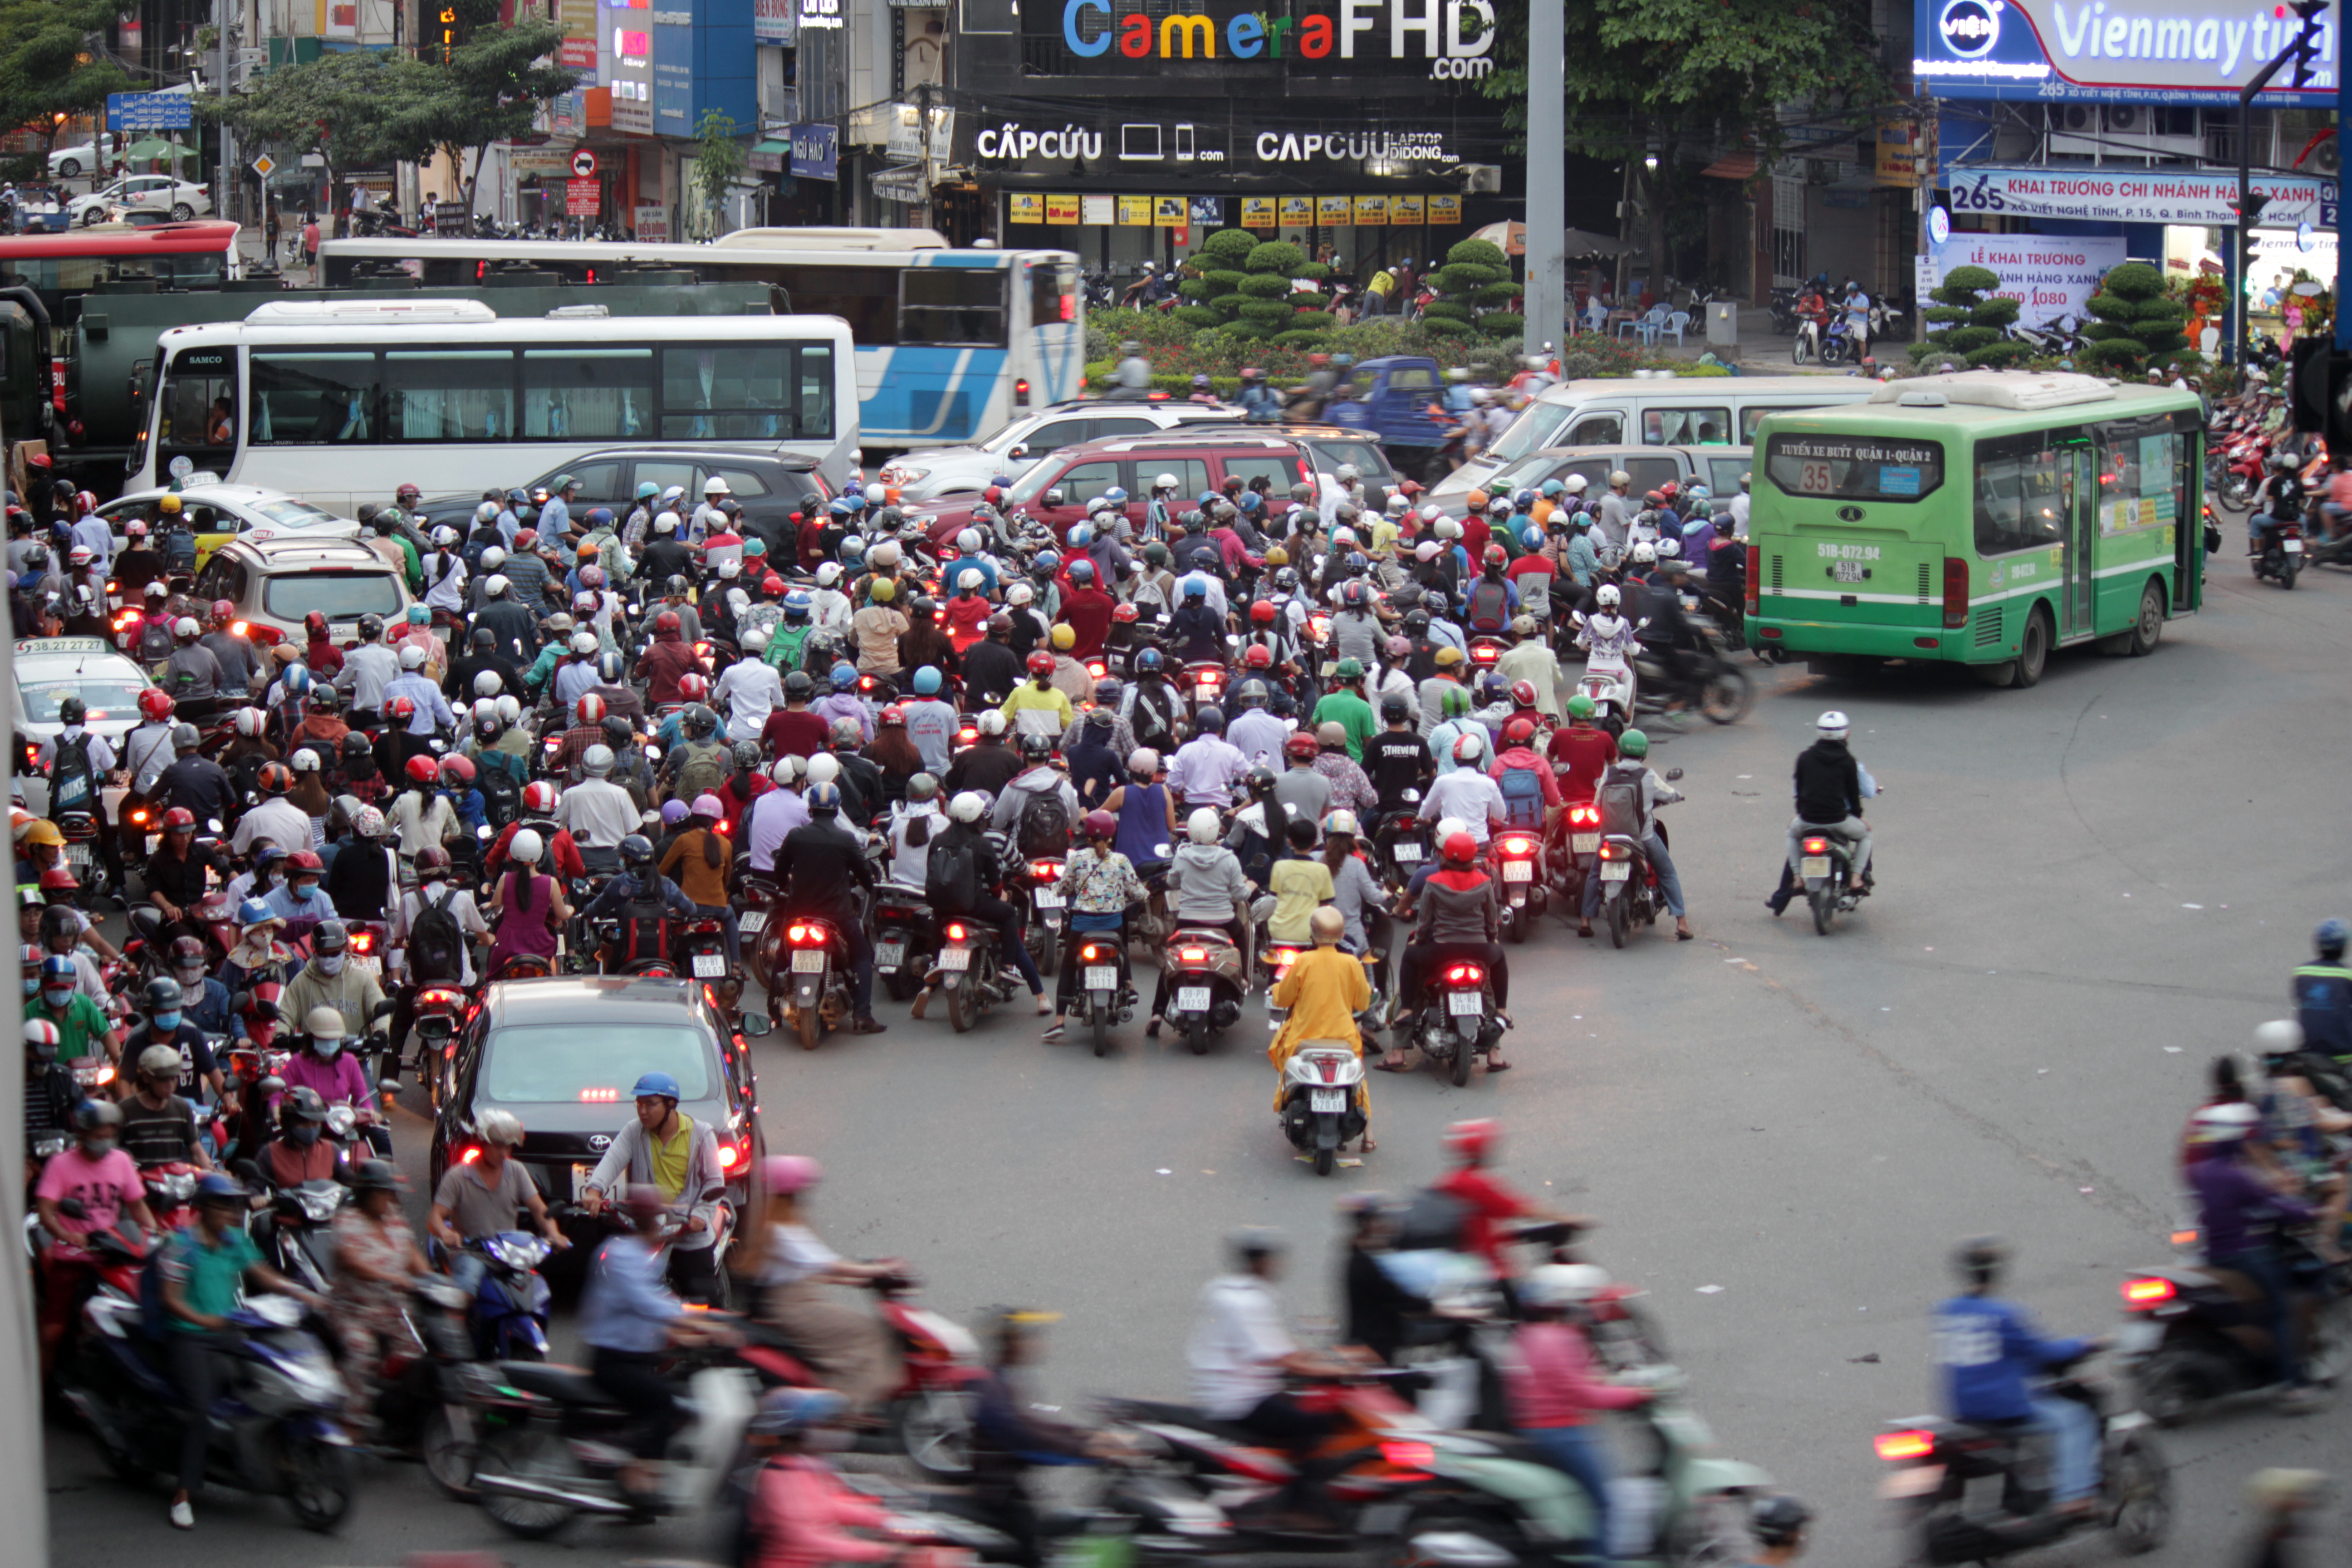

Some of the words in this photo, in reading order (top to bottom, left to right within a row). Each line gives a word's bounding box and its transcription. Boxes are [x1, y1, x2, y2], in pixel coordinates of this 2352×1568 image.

[1940, 15, 1996, 38] VIỆN
[1429, 57, 1493, 80] .com
[2038, 83, 2065, 96] 265
[2081, 88, 2099, 98] VIẾT
[1390, 132, 1443, 146] LAPTOP
[897, 188, 917, 203] MILANO
[1952, 176, 2004, 210] 265
[2008, 179, 2044, 195] KHAI
[2050, 179, 2114, 196] TRƯƠNG
[2119, 182, 2147, 197] CHI
[2153, 180, 2210, 199] NHÁNH
[2215, 181, 2264, 200] HÀG
[2270, 187, 2315, 202] XANH
[2011, 201, 2027, 212] XÔ
[2031, 201, 2053, 215] VIẾT
[2057, 206, 2088, 216] NGHỆ
[2177, 209, 2202, 220] Bình
[1971, 246, 1984, 264] LỄ
[1989, 252, 2022, 265] KHAI
[2027, 252, 2086, 265] TRƯƠNG
[1998, 270, 2023, 283] ÁNH
[2027, 271, 2063, 284] HÀNG
[2067, 274, 2101, 284] XANH
[1781, 441, 1811, 456] TUYẾN
[1813, 445, 1825, 457] XE
[1827, 443, 1852, 458] BUÝT
[1855, 445, 1882, 462] QUẬN
[1925, 451, 1931, 462] 2
[1803, 465, 1829, 491] 35
[1818, 543, 1881, 560] 51B-072.94
[1841, 562, 1856, 572] 51B
[1835, 572, 1861, 582] 072.94
[34, 640, 64, 652] 38.27
[69, 640, 83, 651] 27
[87, 640, 101, 650] 27
[57, 774, 88, 805] NIKE
[1042, 897, 1062, 906] 5812
[698, 957, 718, 966] 59-B1
[799, 953, 818, 961] 59-C1
[696, 967, 723, 975] 366.63
[794, 961, 821, 970] 491.62
[1089, 978, 1112, 987] 0111
[1184, 989, 1205, 998] 59-P1
[1454, 995, 1475, 1003] 54-R2
[1180, 999, 1207, 1008] 892.55
[1455, 1004, 1477, 1013] 7094
[1317, 1089, 1339, 1099] 67-B1
[1313, 1100, 1343, 1110] 520.66
